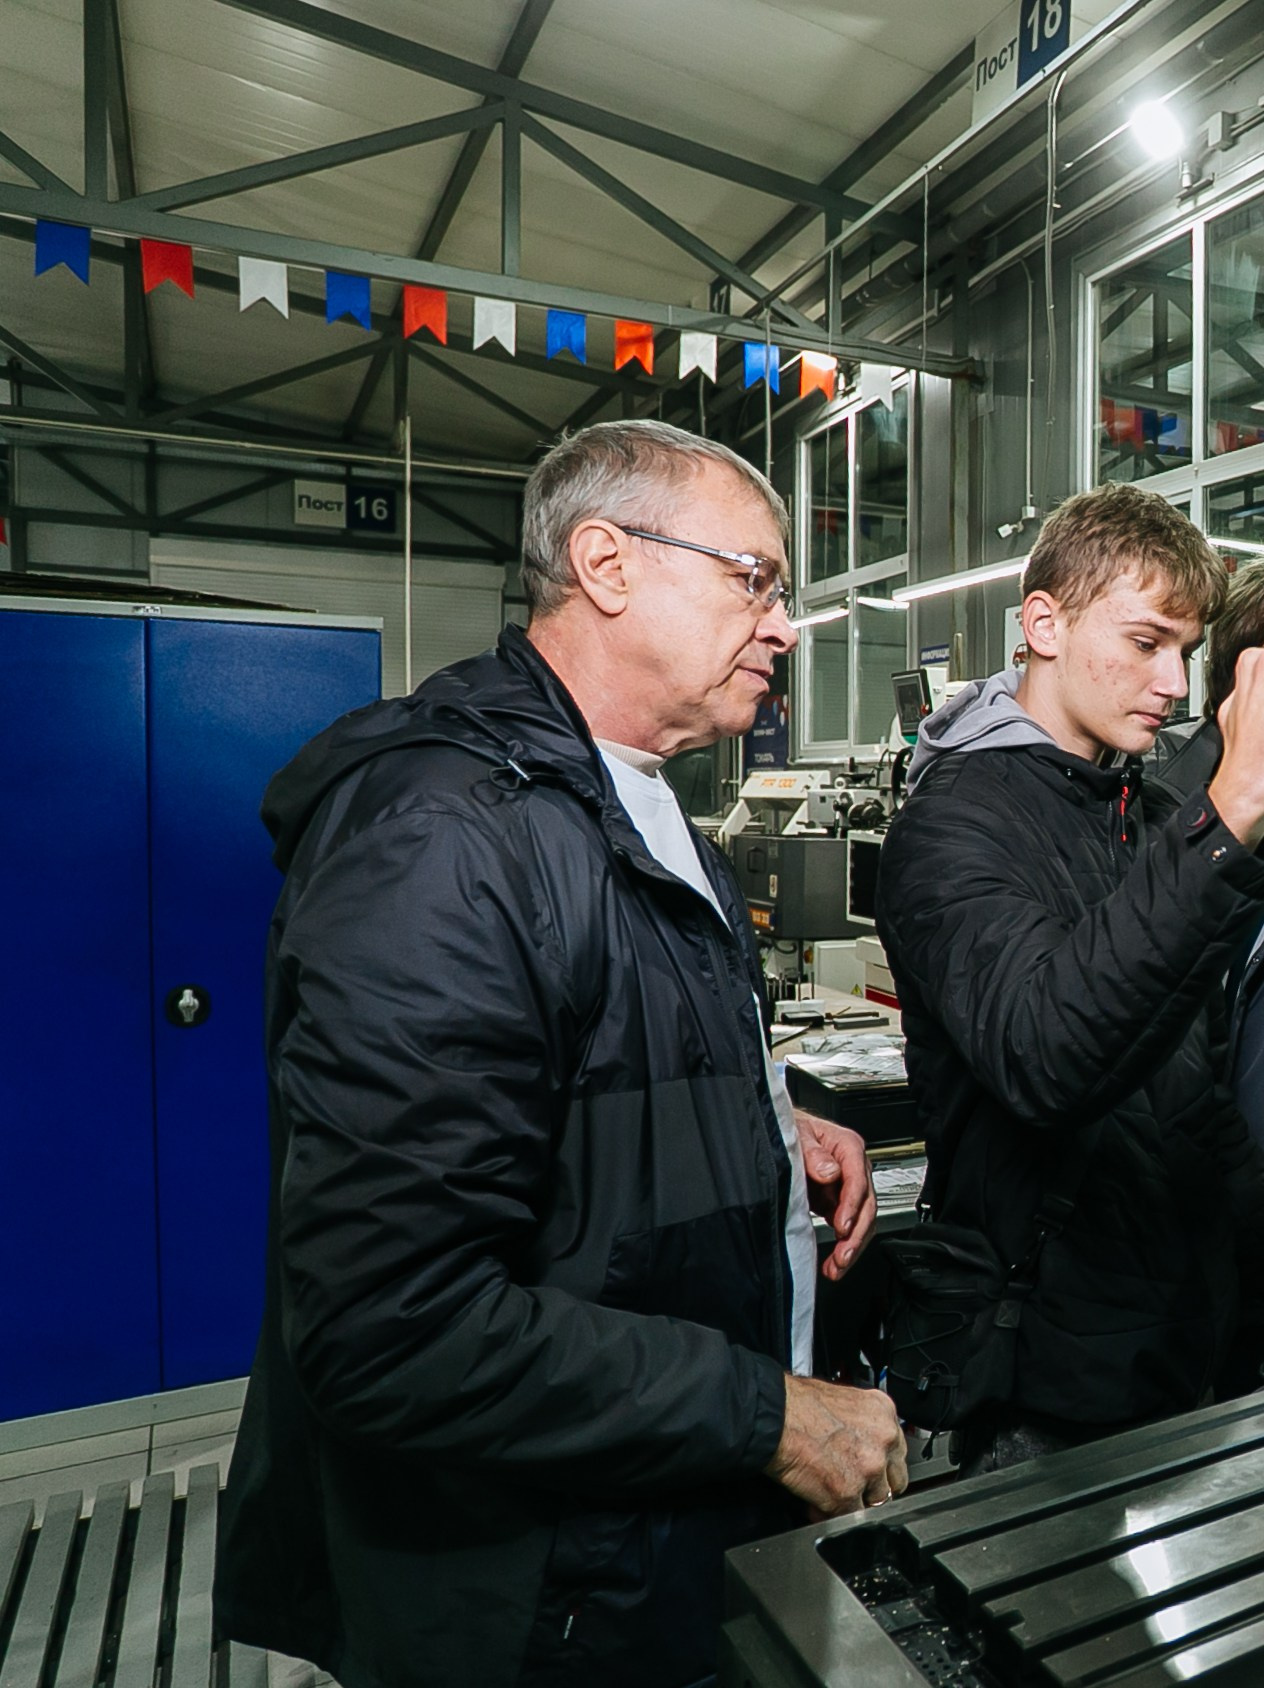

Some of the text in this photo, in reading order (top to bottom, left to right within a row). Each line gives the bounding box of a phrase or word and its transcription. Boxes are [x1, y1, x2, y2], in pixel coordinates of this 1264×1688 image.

[975, 0, 1063, 92] Пост 18
[297, 494, 388, 520] Пост 16
